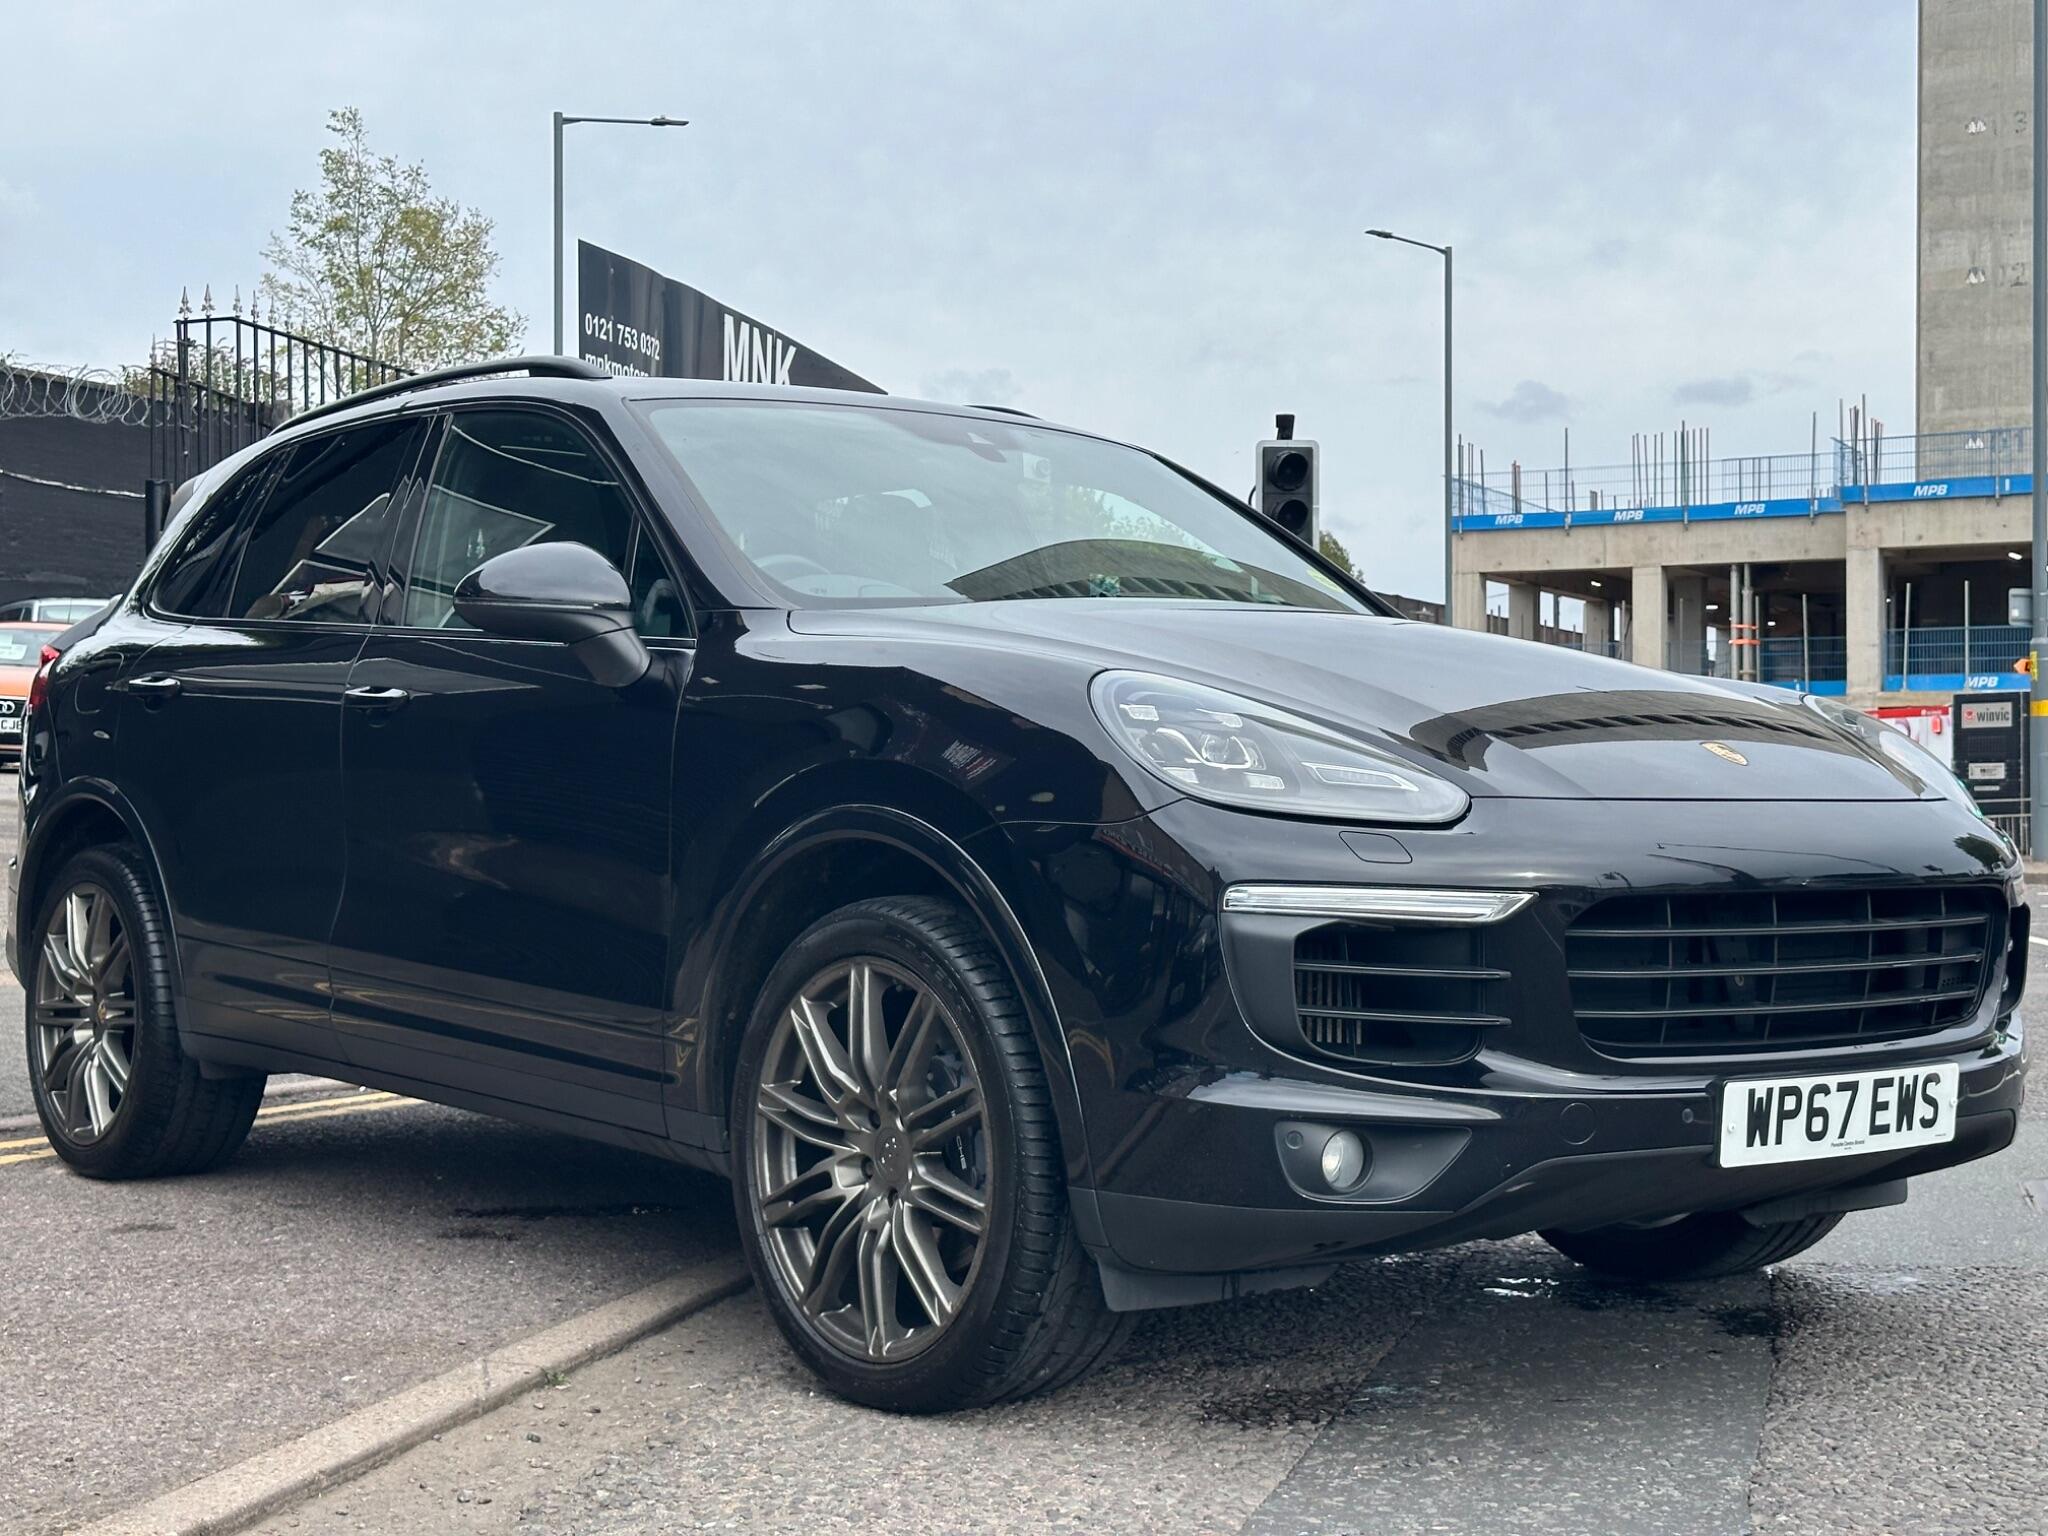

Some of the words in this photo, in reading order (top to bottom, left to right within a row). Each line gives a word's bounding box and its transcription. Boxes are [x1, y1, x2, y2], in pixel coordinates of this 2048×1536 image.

[585, 313, 613, 343] 0121
[617, 323, 638, 350] 753
[640, 332, 660, 361] 0372
[724, 311, 797, 385] MNK
[1913, 484, 1948, 497] MPB
[1614, 510, 1644, 521] MPB
[1734, 504, 1766, 516] MPB
[1495, 514, 1524, 525] MPB
[1963, 676, 1999, 688] MPB
[1746, 1080, 1860, 1148] WP67
[1869, 1072, 1941, 1136] EWS
